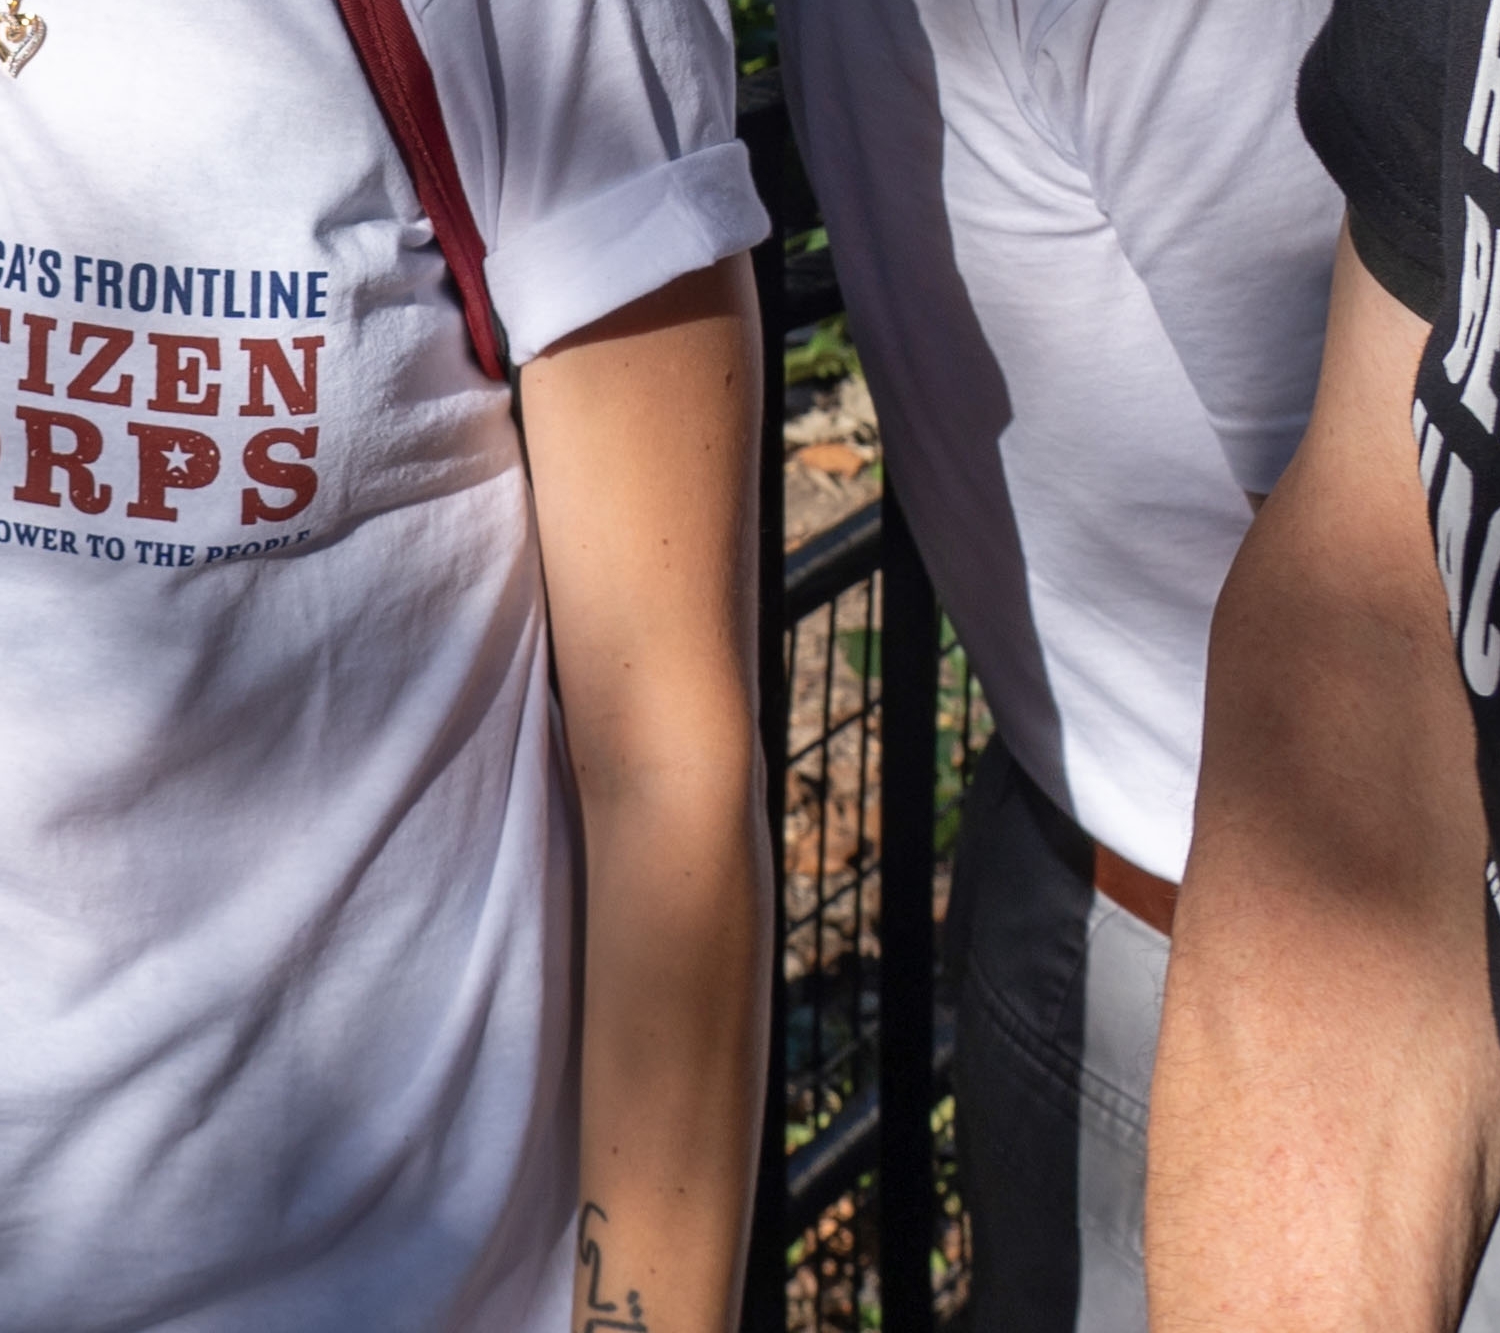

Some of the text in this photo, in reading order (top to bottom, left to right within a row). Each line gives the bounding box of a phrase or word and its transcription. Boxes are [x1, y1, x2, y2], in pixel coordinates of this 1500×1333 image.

[74, 256, 330, 319] FRONTLINE
[86, 533, 126, 562] TO
[134, 539, 196, 568] THE
